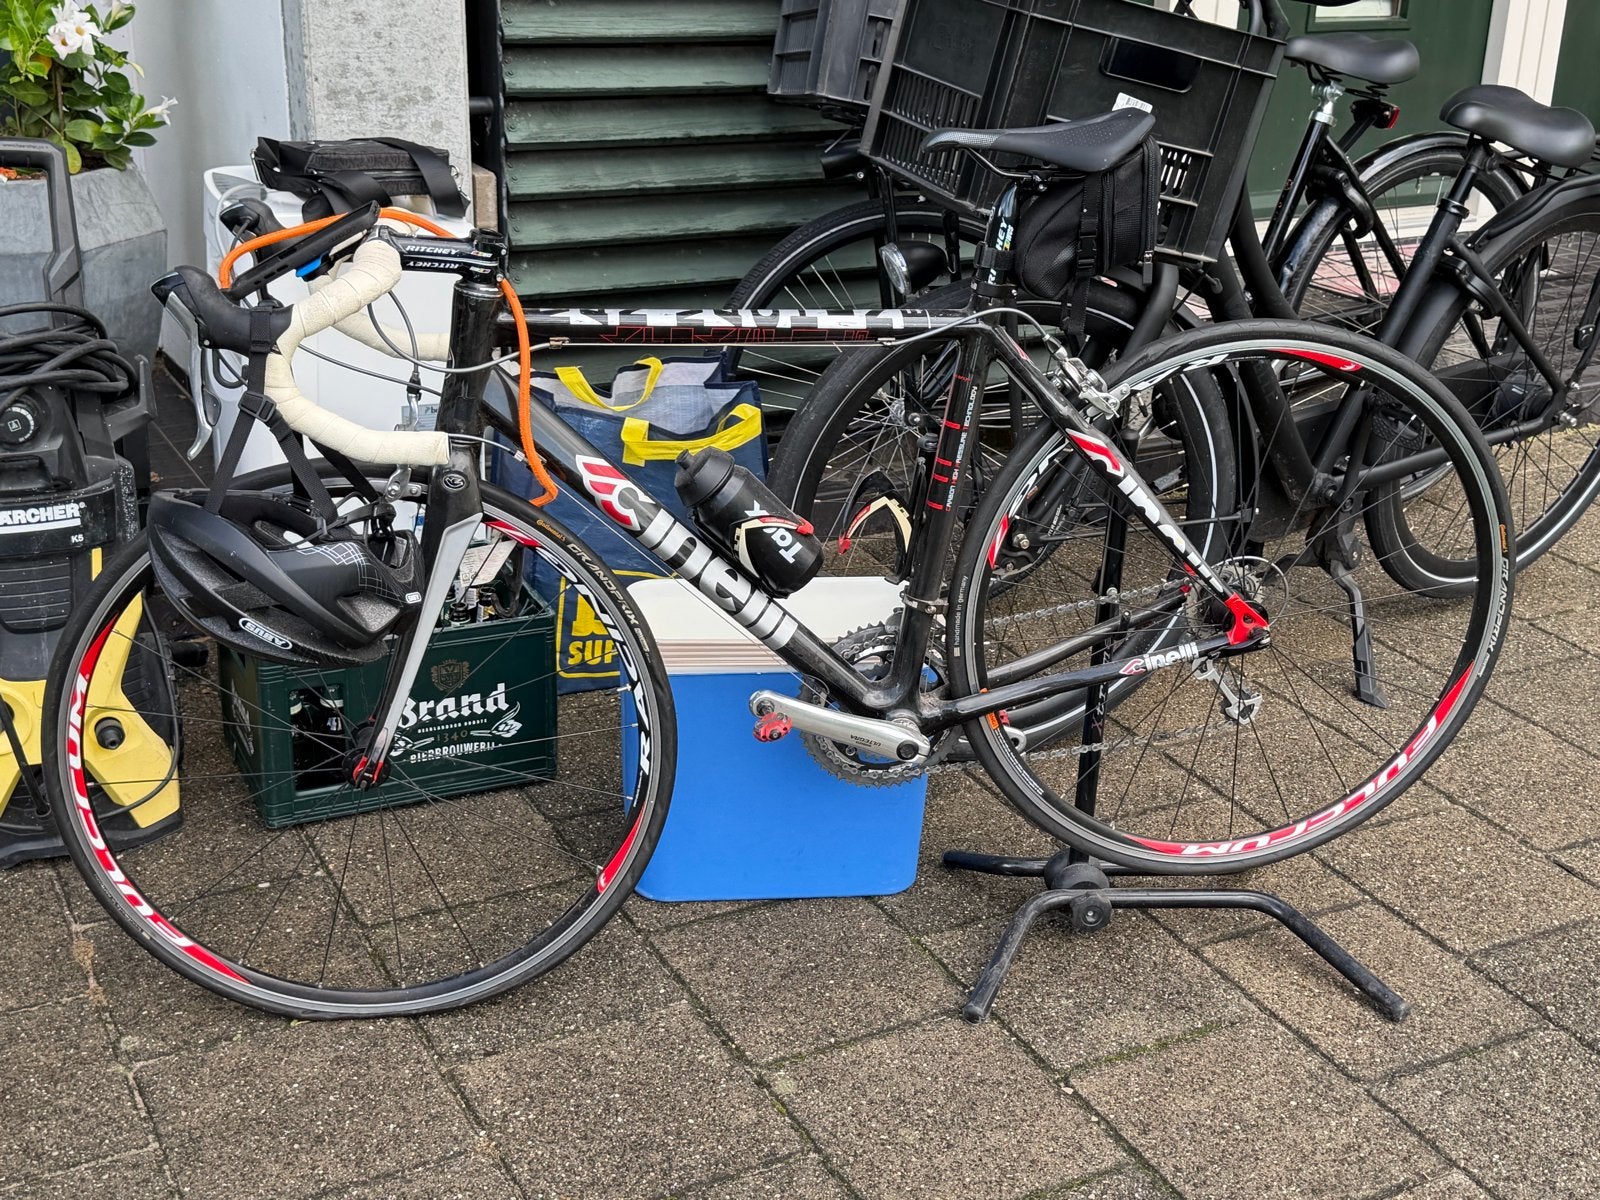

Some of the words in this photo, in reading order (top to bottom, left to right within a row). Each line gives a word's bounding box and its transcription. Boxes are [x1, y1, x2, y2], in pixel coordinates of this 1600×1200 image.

[405, 245, 460, 255] RITCHEY
[988, 217, 1008, 284] RIHEY
[954, 431, 968, 468] PRESSURE
[962, 386, 978, 430] TECHNOLOGY
[0, 503, 80, 525] ÄRCHER
[70, 534, 84, 544] K5
[957, 576, 969, 604] germany
[244, 620, 288, 648] ABUS
[953, 611, 962, 646] handmade
[1090, 638, 1112, 737] Xtrme
[398, 682, 510, 729] Brand
[436, 730, 469, 742] 1340
[1180, 714, 1438, 856] FULCRUM
[69, 672, 195, 947] FULCRUM
